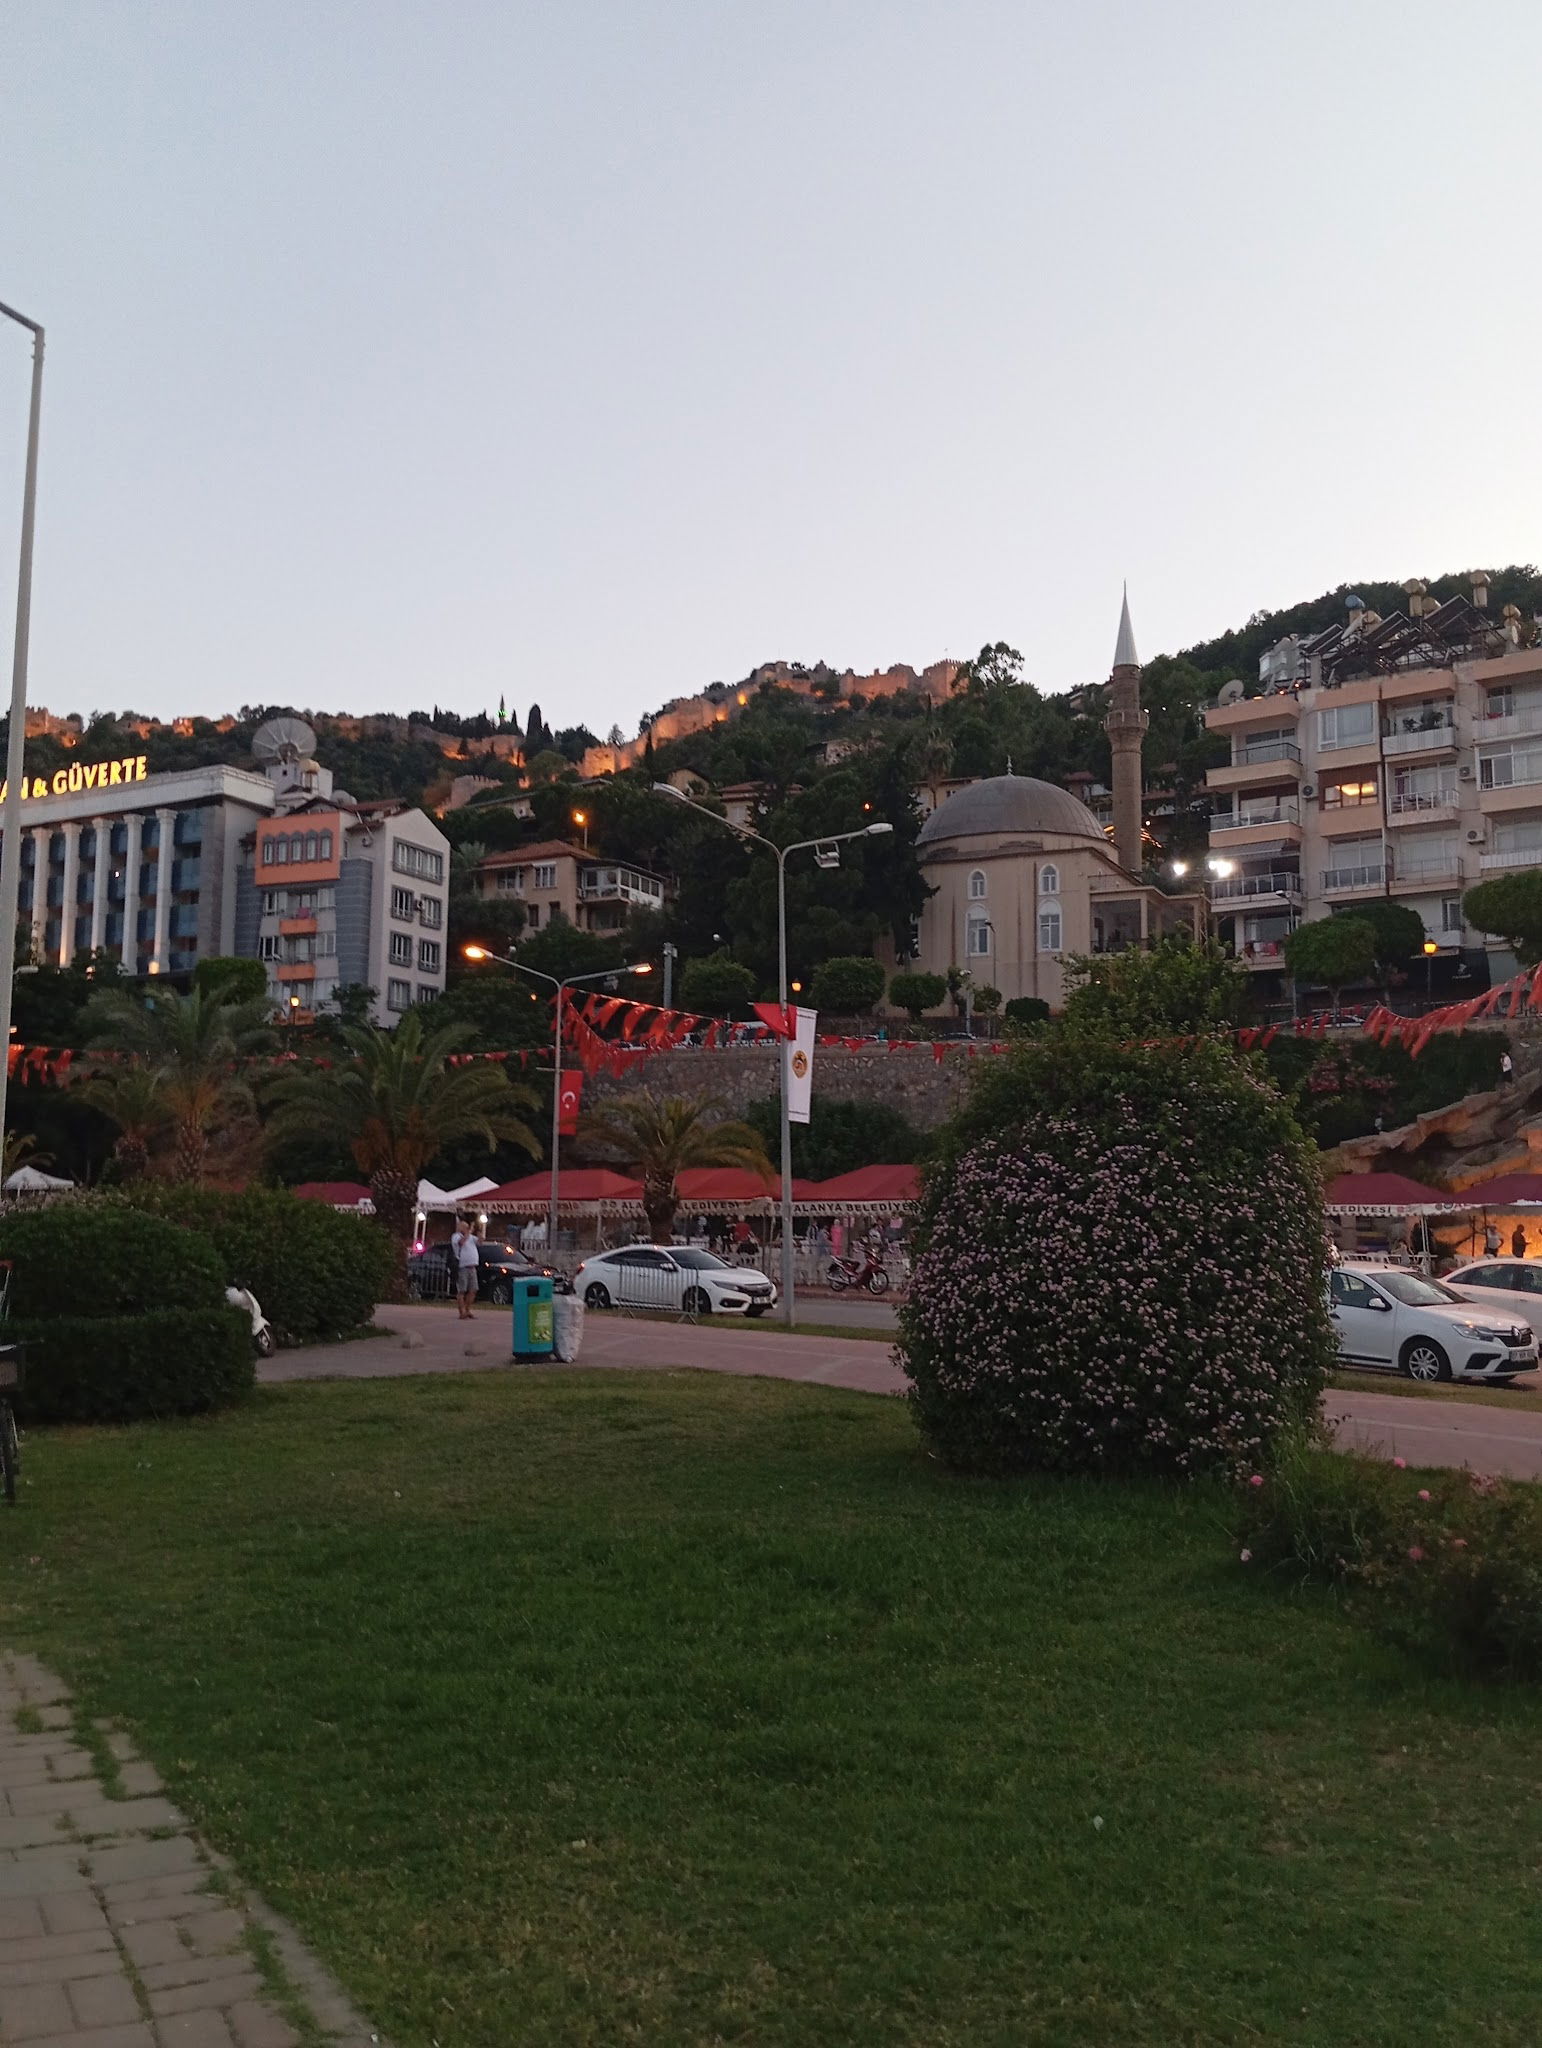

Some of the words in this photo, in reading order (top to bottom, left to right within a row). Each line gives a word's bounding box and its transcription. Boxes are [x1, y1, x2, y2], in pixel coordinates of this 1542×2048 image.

[32, 777, 49, 798] &
[52, 755, 148, 795] GÜVERTE
[793, 1203, 843, 1212] ALANYA
